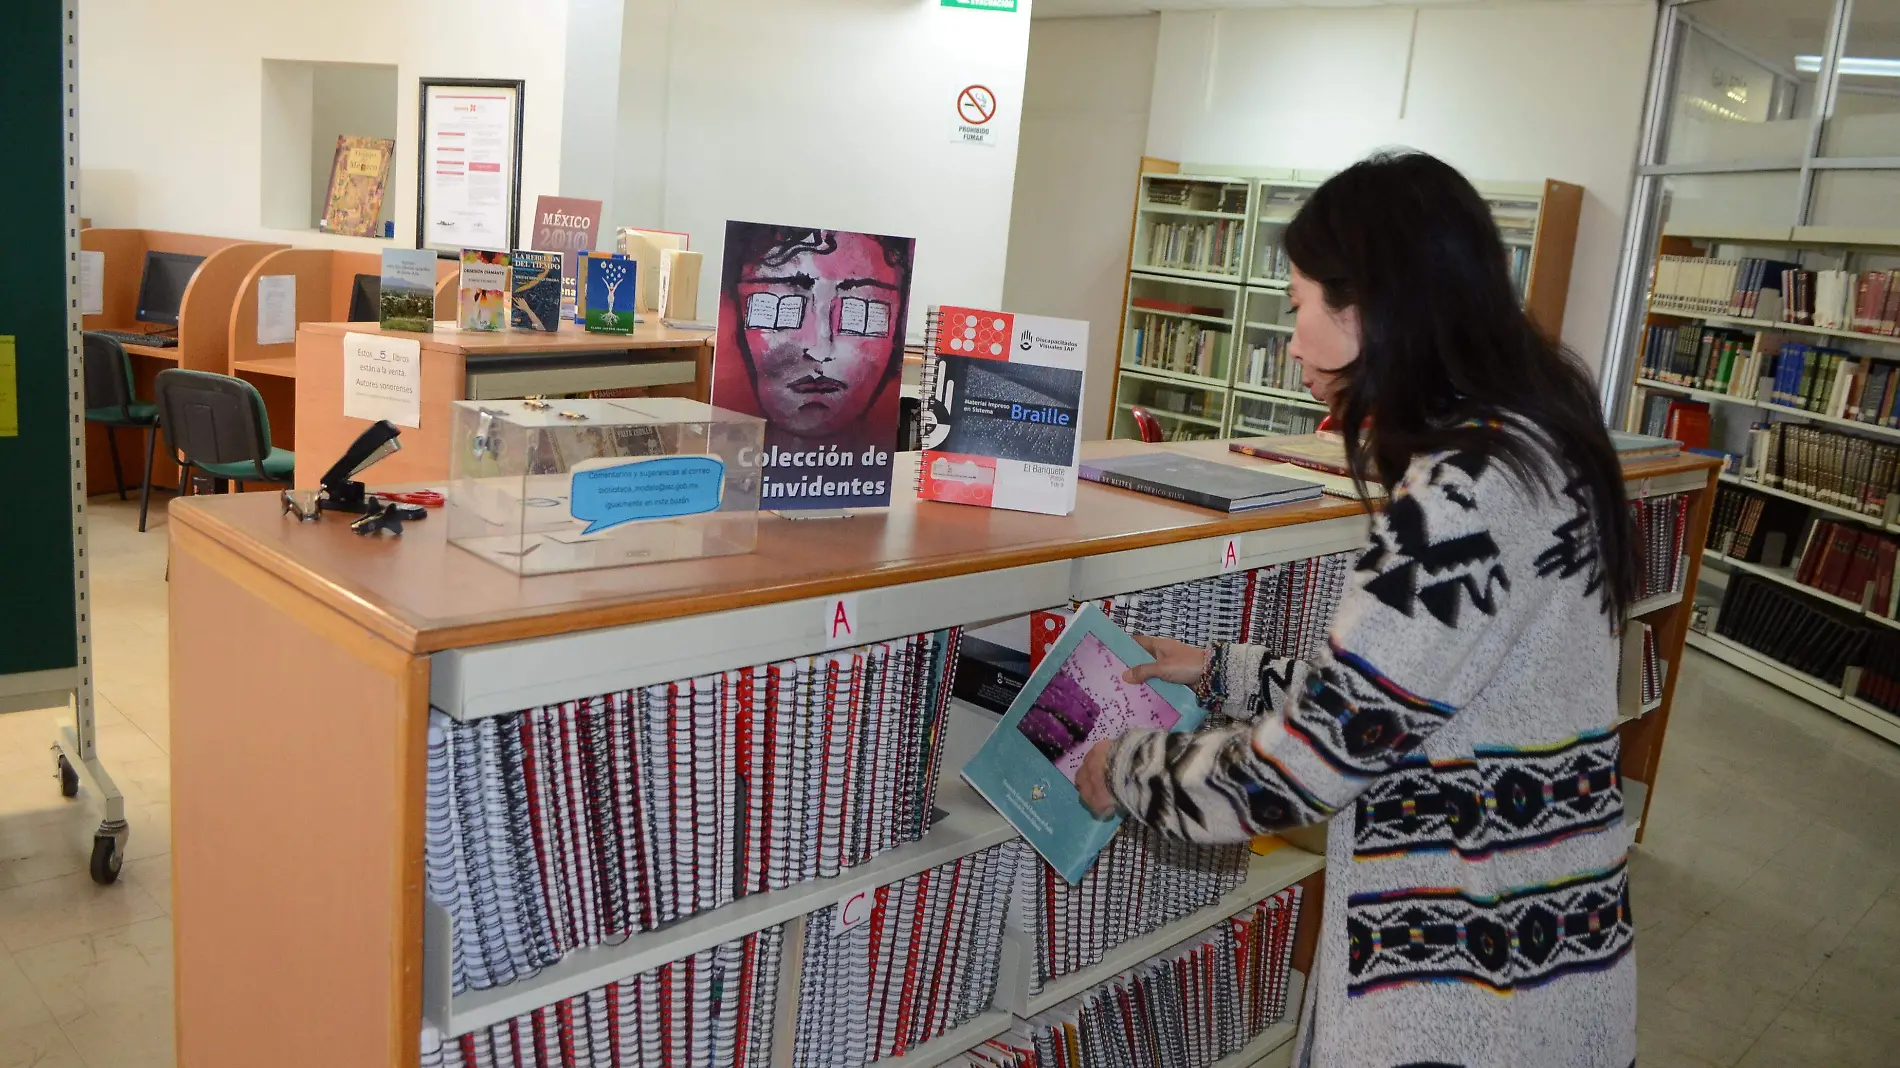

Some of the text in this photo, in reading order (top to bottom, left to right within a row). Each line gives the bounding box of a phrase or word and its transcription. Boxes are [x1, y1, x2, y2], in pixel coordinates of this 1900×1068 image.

[958, 126, 989, 135] PROHIBIDO
[963, 133, 984, 141] FUMAR
[542, 209, 591, 229] MÉXICO
[540, 228, 588, 250] 2010
[515, 260, 561, 270] DEL TIEMPO
[1035, 336, 1078, 347] Discapacitados
[1039, 343, 1062, 351] Visuales
[357, 348, 410, 363] Estos 5 libros
[359, 364, 376, 373] están
[381, 366, 387, 374] la
[388, 369, 407, 377] venta.
[355, 378, 413, 394] Autores sonorenses
[964, 399, 987, 407] Material
[1011, 404, 1070, 426] Braille
[971, 405, 994, 415] Sistema
[738, 444, 888, 467] Colección de
[588, 471, 632, 480] Comentarios
[640, 468, 679, 478] sugerencias
[681, 467, 688, 475] al
[1023, 463, 1065, 476] El Banquete
[762, 475, 886, 498] invidentes
[1225, 541, 1237, 569] A
[833, 600, 851, 639] A
[843, 891, 865, 926] C
